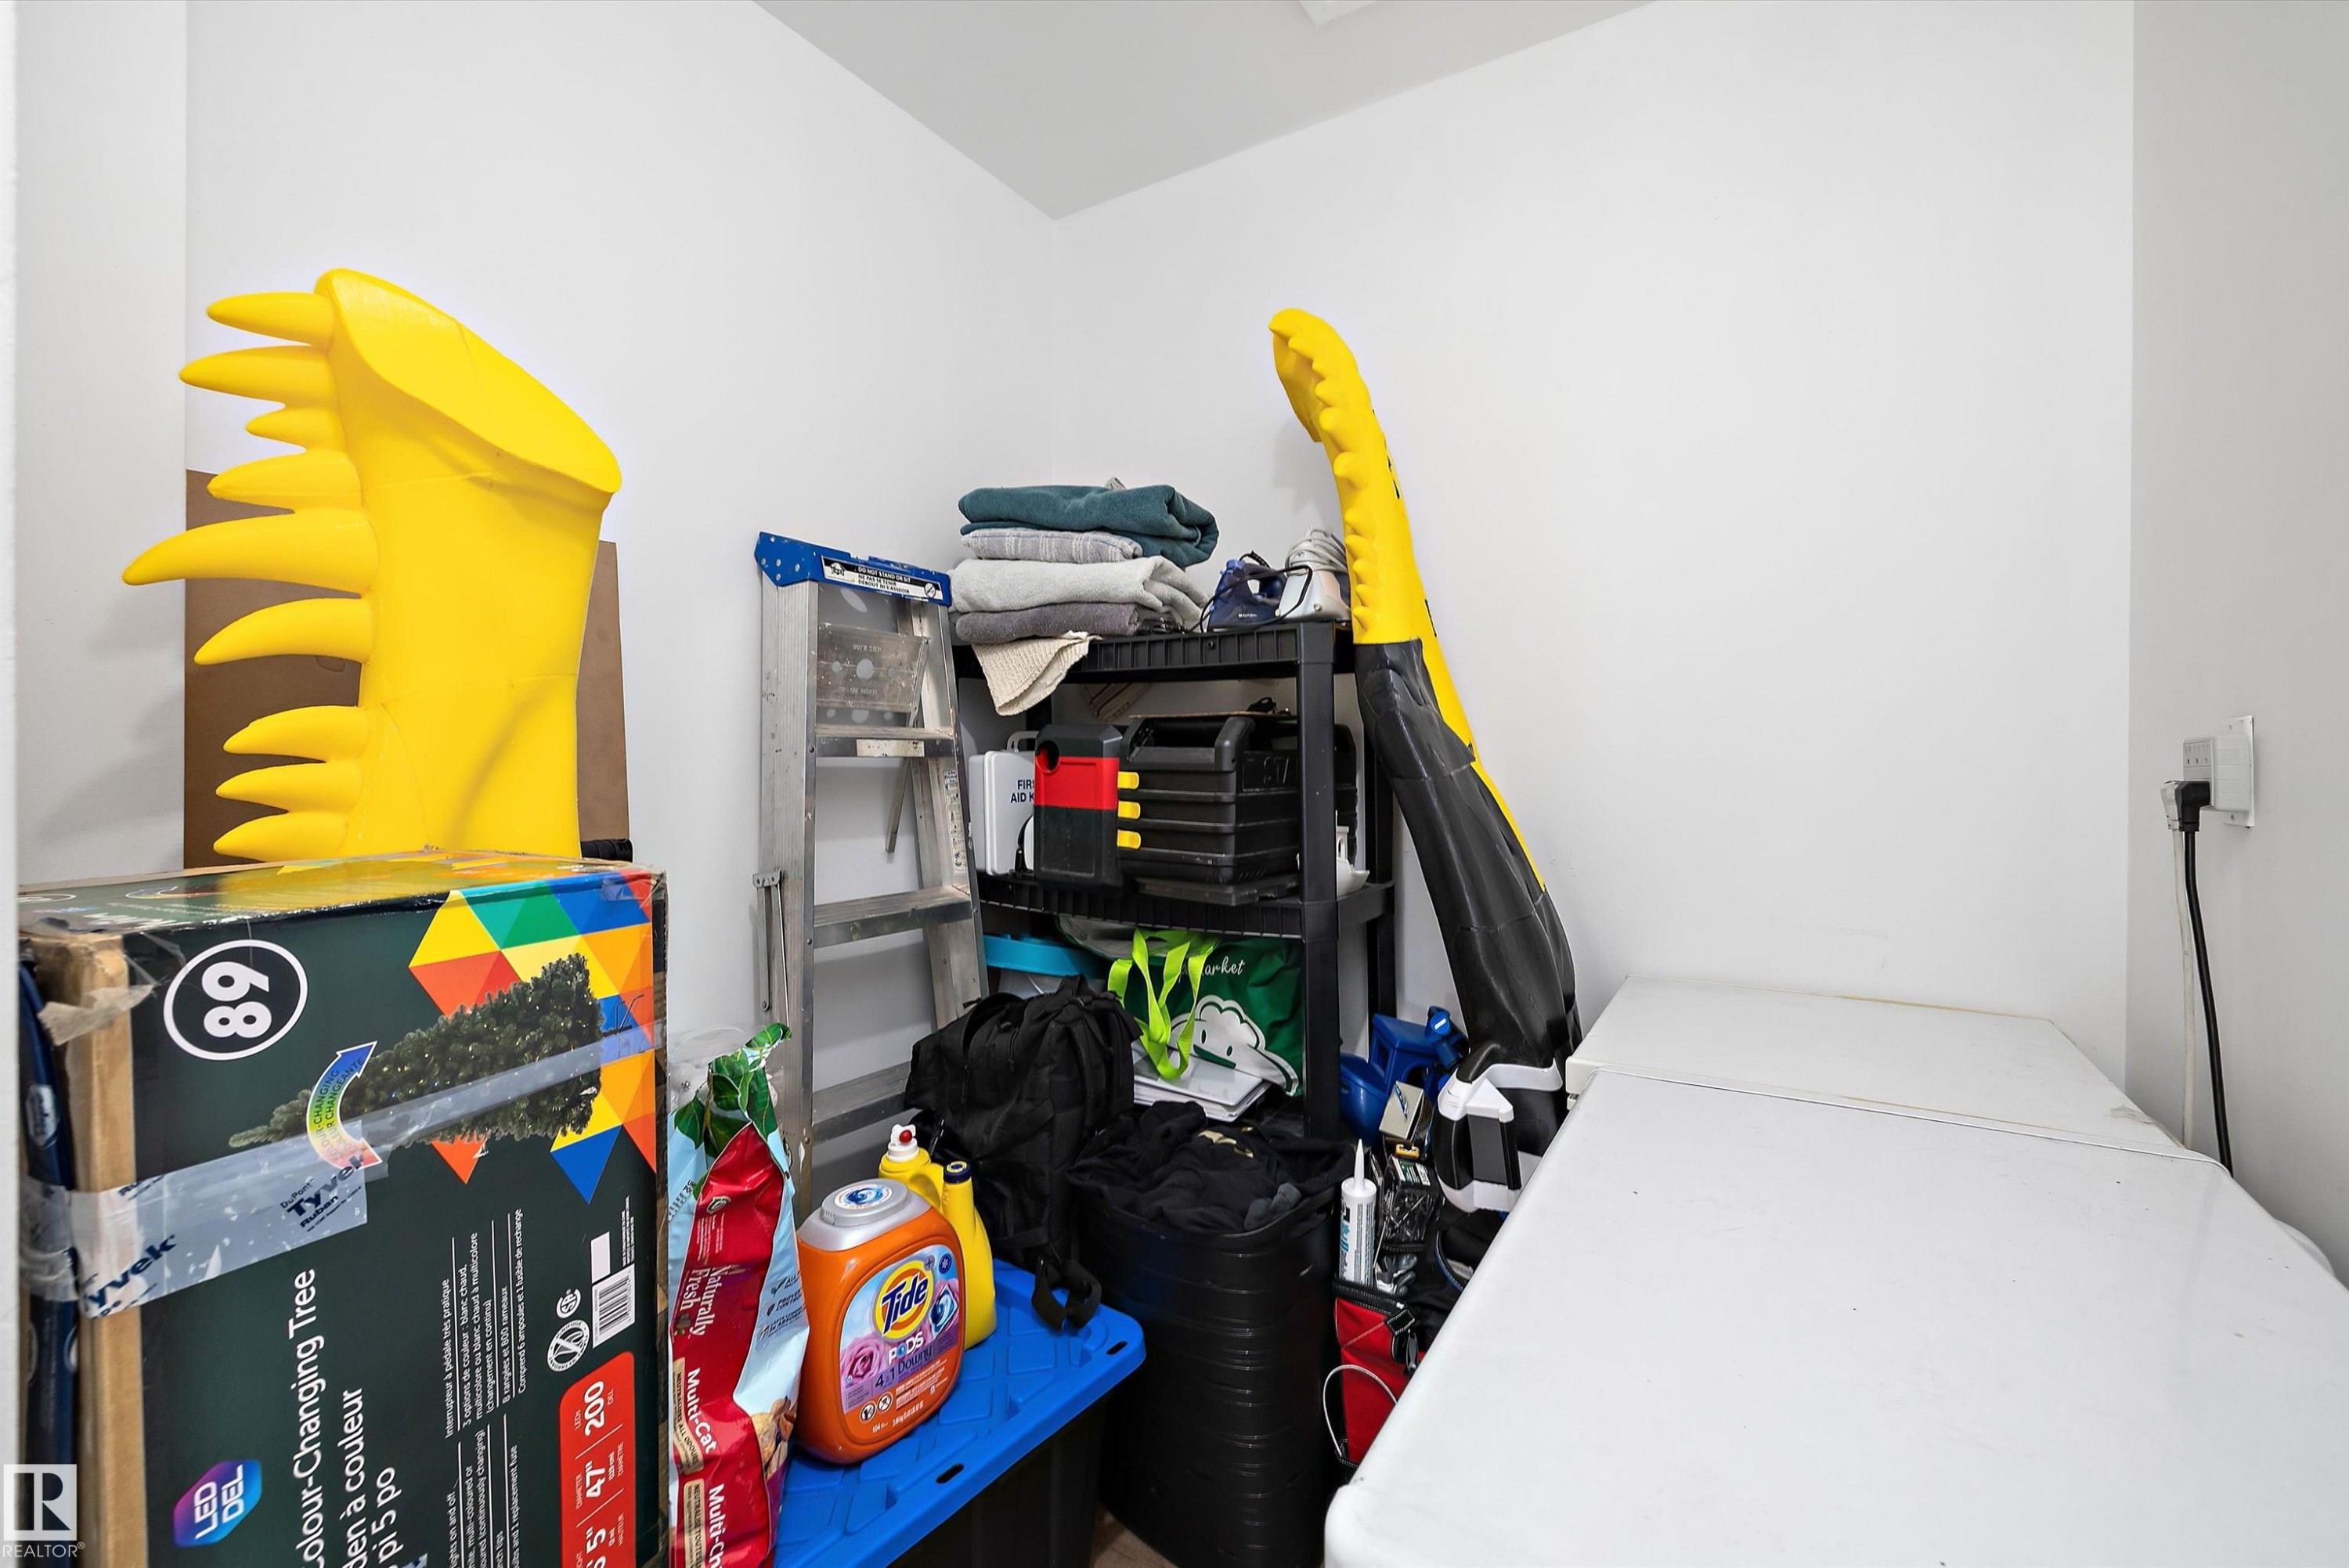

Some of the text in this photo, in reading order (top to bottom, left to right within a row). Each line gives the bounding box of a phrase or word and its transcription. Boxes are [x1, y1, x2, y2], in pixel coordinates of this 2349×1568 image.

[879, 571, 896, 579] STAND
[1010, 792, 1027, 803] AID
[201, 961, 272, 1038] 89
[324, 1057, 366, 1120] CHANGEANTE
[286, 1153, 365, 1217] Tyvek
[299, 1195, 339, 1228] Ruban
[514, 1208, 524, 1249] rechange
[514, 1247, 523, 1260] de
[514, 1258, 524, 1286] fusible
[440, 1278, 452, 1318] pratique
[458, 1264, 468, 1297] chaud,
[516, 1292, 525, 1303] et
[679, 1267, 711, 1312] Fresh
[288, 1268, 316, 1339] Tree
[460, 1298, 469, 1325] blanc
[689, 1264, 732, 1336] Naturally
[881, 1271, 929, 1338] Tide
[442, 1319, 452, 1339] très
[469, 1232, 483, 1421] multicolore ou blanc chaud à multicolore
[516, 1302, 527, 1343] ampoules
[442, 1339, 454, 1372] pédale
[460, 1331, 471, 1368] couleur
[482, 1299, 496, 1414] (changement en continu)
[500, 1285, 512, 1404] 8 rangées et 800 rameaux
[888, 1331, 924, 1365] PODS
[461, 1367, 471, 1382] de
[517, 1348, 528, 1394] Comprend
[875, 1374, 884, 1388] 4
[898, 1346, 933, 1375] Downy
[443, 1382, 455, 1439] Interrupteur
[462, 1381, 473, 1418] options
[583, 1381, 605, 1436] 200
[687, 1367, 718, 1454] Multi-Cat
[337, 1387, 365, 1492] couleur
[462, 1418, 472, 1429] 3
[677, 1424, 687, 1436] ALL
[465, 1465, 473, 1477] or
[474, 1429, 485, 1477] changing)
[509, 1444, 518, 1467] fuse
[221, 1464, 244, 1524] DEL
[508, 1465, 521, 1523] replacement
[584, 1460, 606, 1498] 47"
[193, 1481, 218, 1540] LED
[338, 1494, 366, 1520] à
[370, 1466, 404, 1564] pi 5 po
[446, 1491, 456, 1506] off
[447, 1506, 456, 1527] and
[464, 1477, 475, 1548] multi-coloured
[475, 1476, 487, 1541] (continuously
[449, 1526, 457, 1541] on
[494, 1530, 505, 1551] tips
[510, 1521, 519, 1530] 1
[511, 1529, 520, 1548] and
[586, 1526, 607, 1555] 5"
